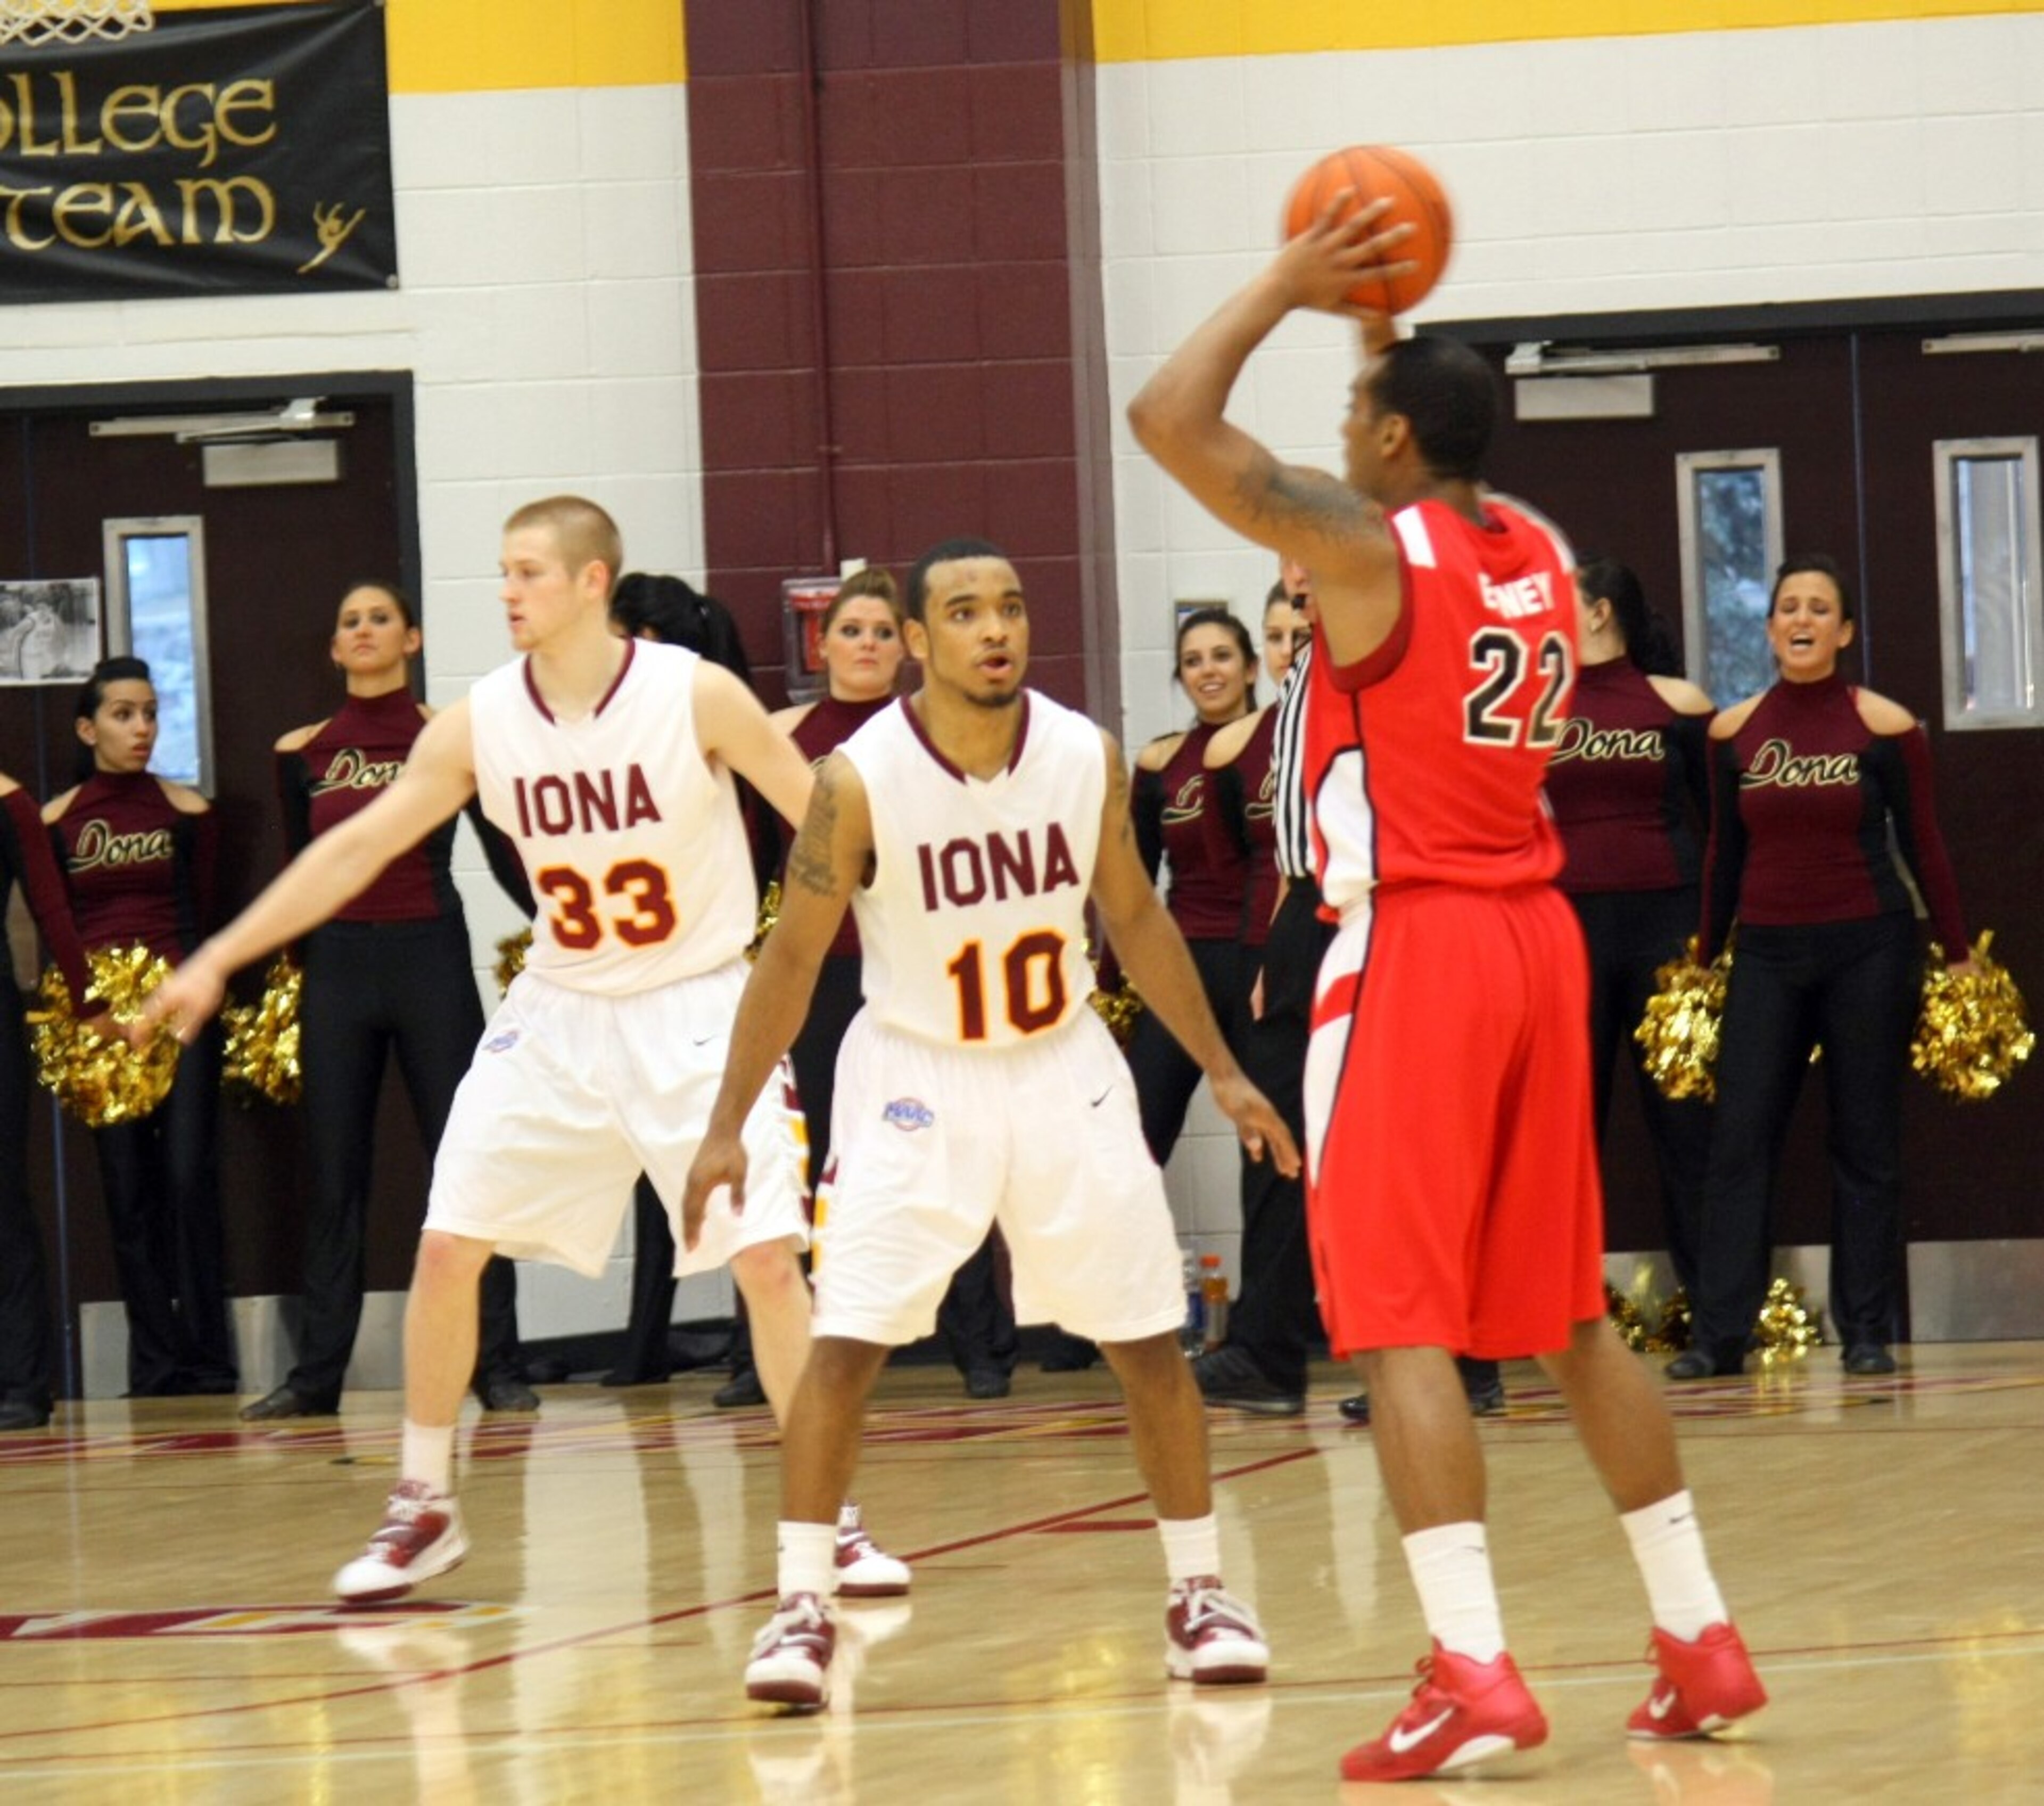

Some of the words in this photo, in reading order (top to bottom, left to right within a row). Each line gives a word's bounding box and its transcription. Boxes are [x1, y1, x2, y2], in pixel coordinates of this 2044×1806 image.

[0, 71, 277, 168] LLEGE
[1462, 625, 1576, 749] 22
[513, 763, 663, 839] IONA
[537, 858, 679, 951] 33
[917, 821, 1079, 912] IONA
[945, 925, 1069, 1044] 10
